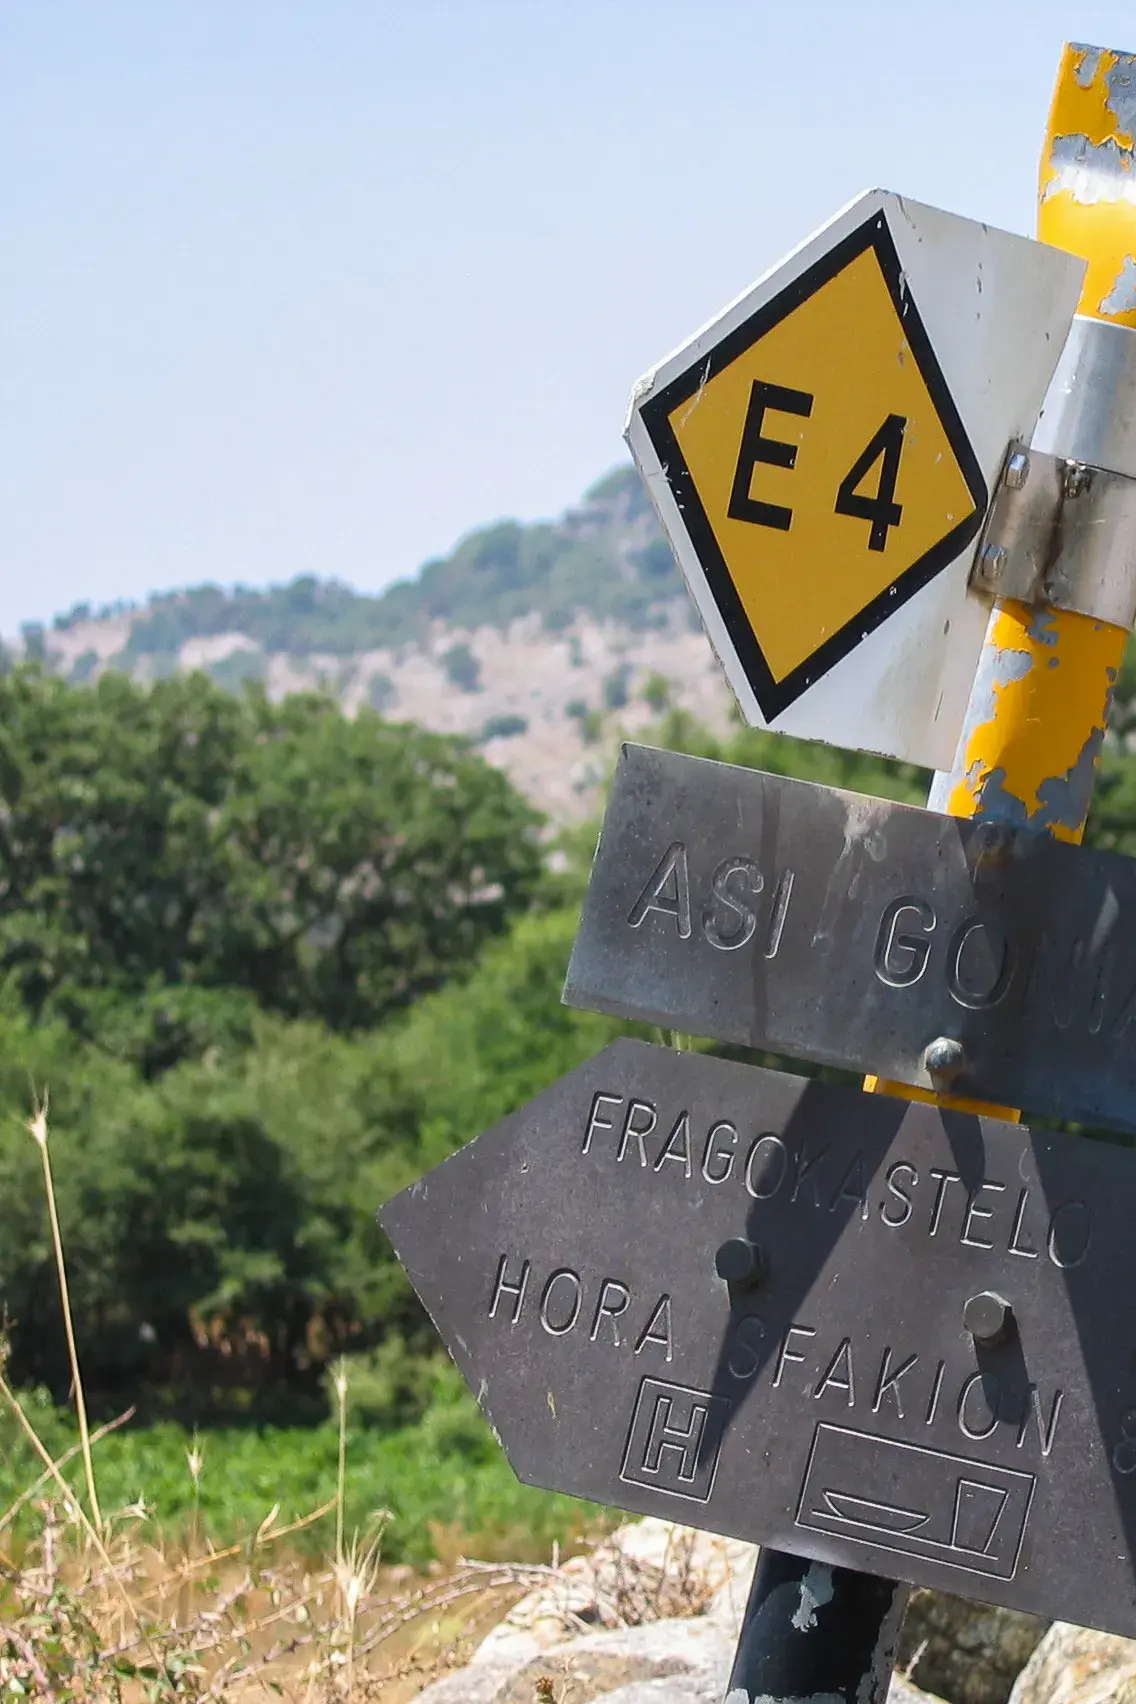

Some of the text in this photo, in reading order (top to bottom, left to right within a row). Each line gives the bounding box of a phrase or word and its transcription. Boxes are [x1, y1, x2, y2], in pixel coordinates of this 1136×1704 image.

[727, 379, 908, 552] E 4
[627, 841, 795, 959] ASI
[581, 1091, 1092, 1269] FRAGOKASTELO
[488, 1253, 673, 1362] HORA
[729, 1315, 1064, 1457] SFAKION
